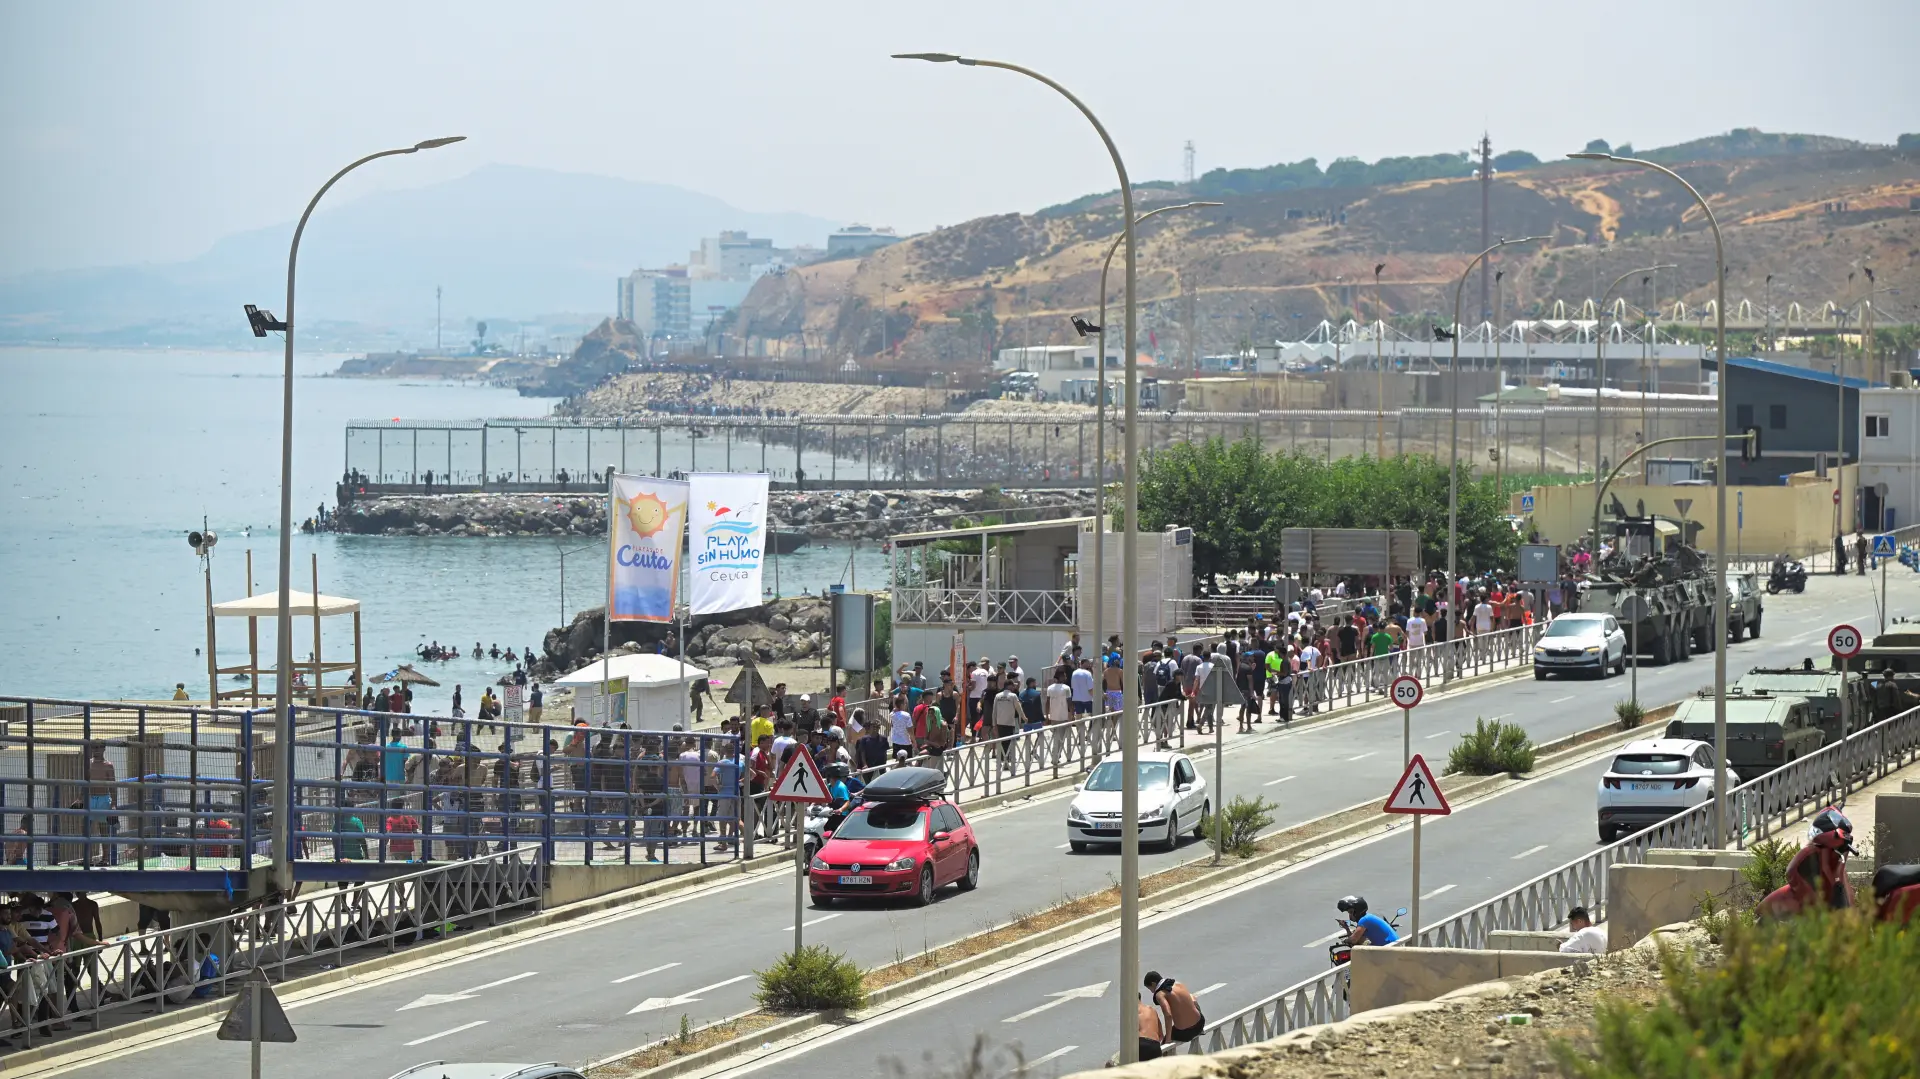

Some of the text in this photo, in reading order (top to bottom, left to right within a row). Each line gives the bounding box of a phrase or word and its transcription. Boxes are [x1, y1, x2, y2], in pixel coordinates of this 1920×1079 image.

[707, 535, 748, 550] PLAYA
[616, 544, 673, 570] Ceuta
[719, 548, 760, 560] HUMO
[710, 570, 749, 582] Ceuta
[1835, 635, 1854, 647] 50
[1397, 686, 1416, 698] 50
